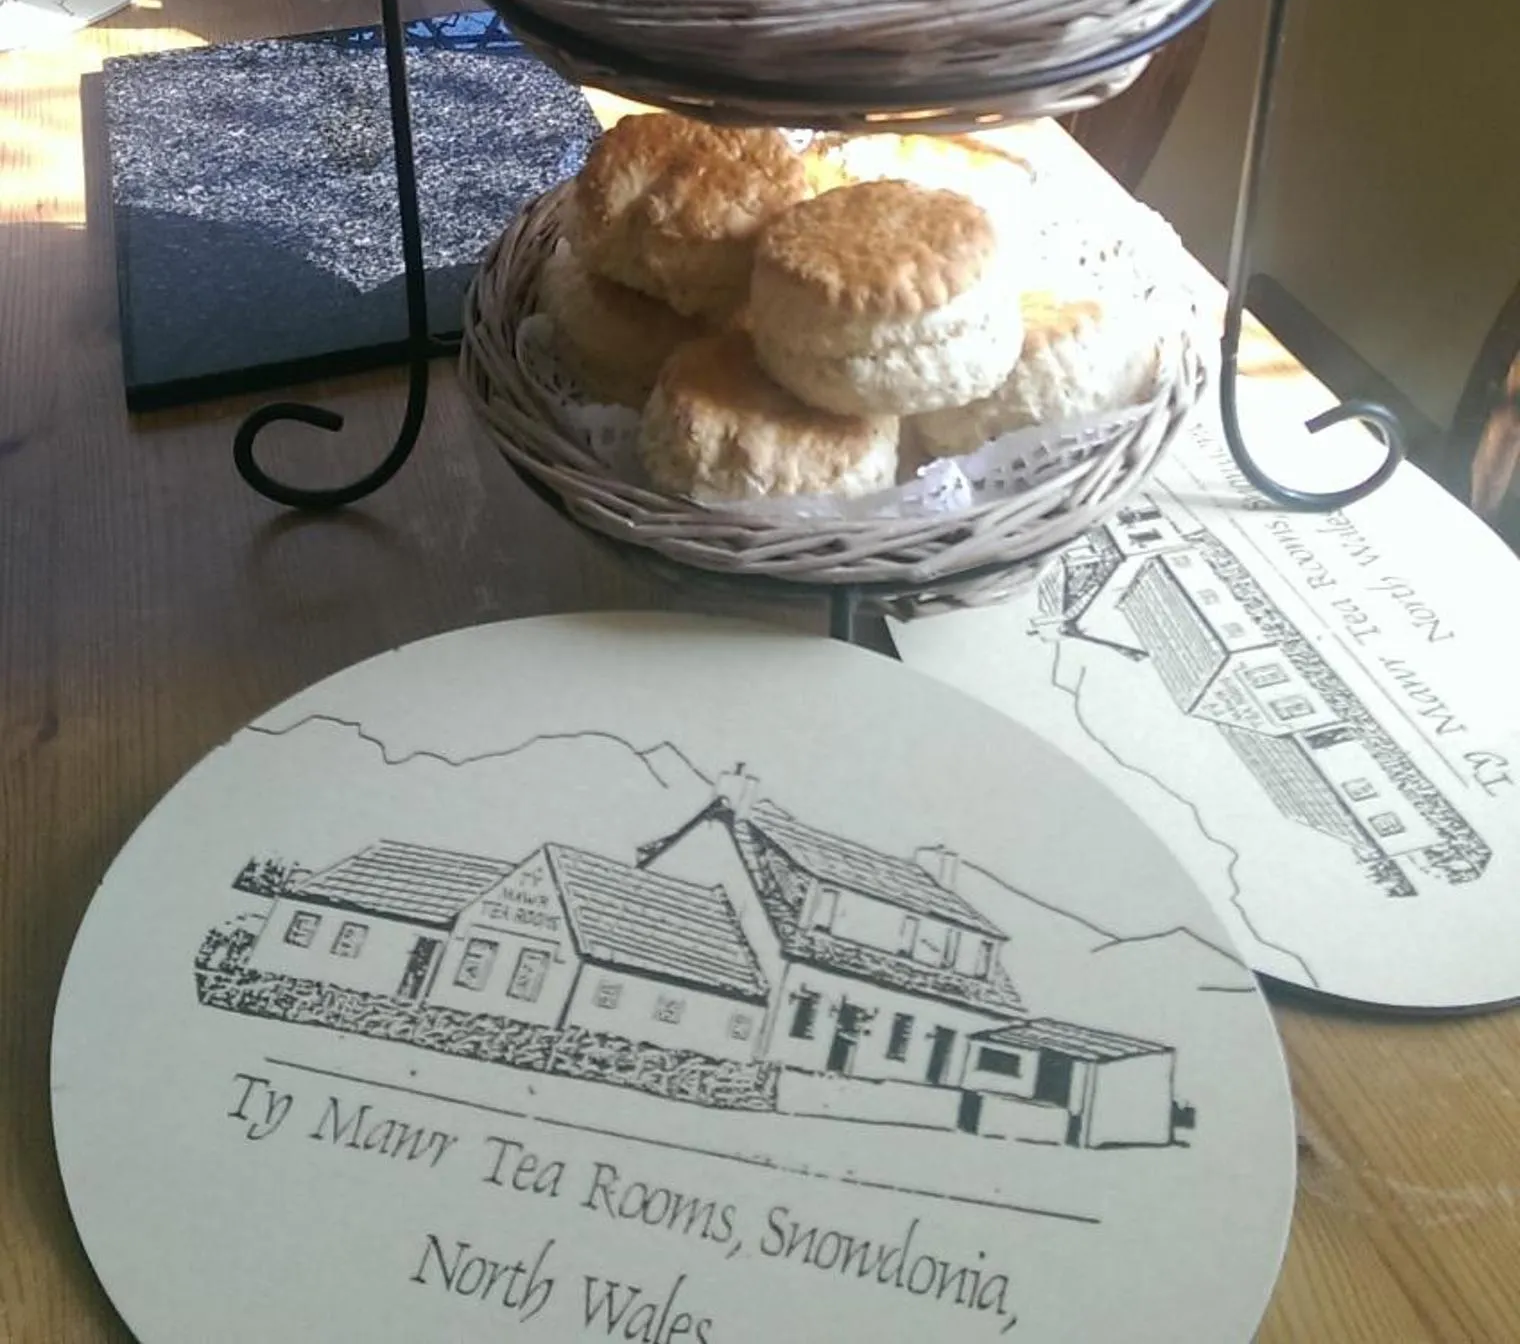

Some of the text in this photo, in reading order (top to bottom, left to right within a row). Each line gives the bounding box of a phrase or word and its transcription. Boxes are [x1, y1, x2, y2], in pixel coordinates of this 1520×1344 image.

[1330, 598, 1382, 646] Tea
[1363, 575, 1455, 643] North
[228, 1073, 1018, 1334] Ty Mawr Tea Rooms, Snowdonia,
[410, 1234, 713, 1344] North Wales
